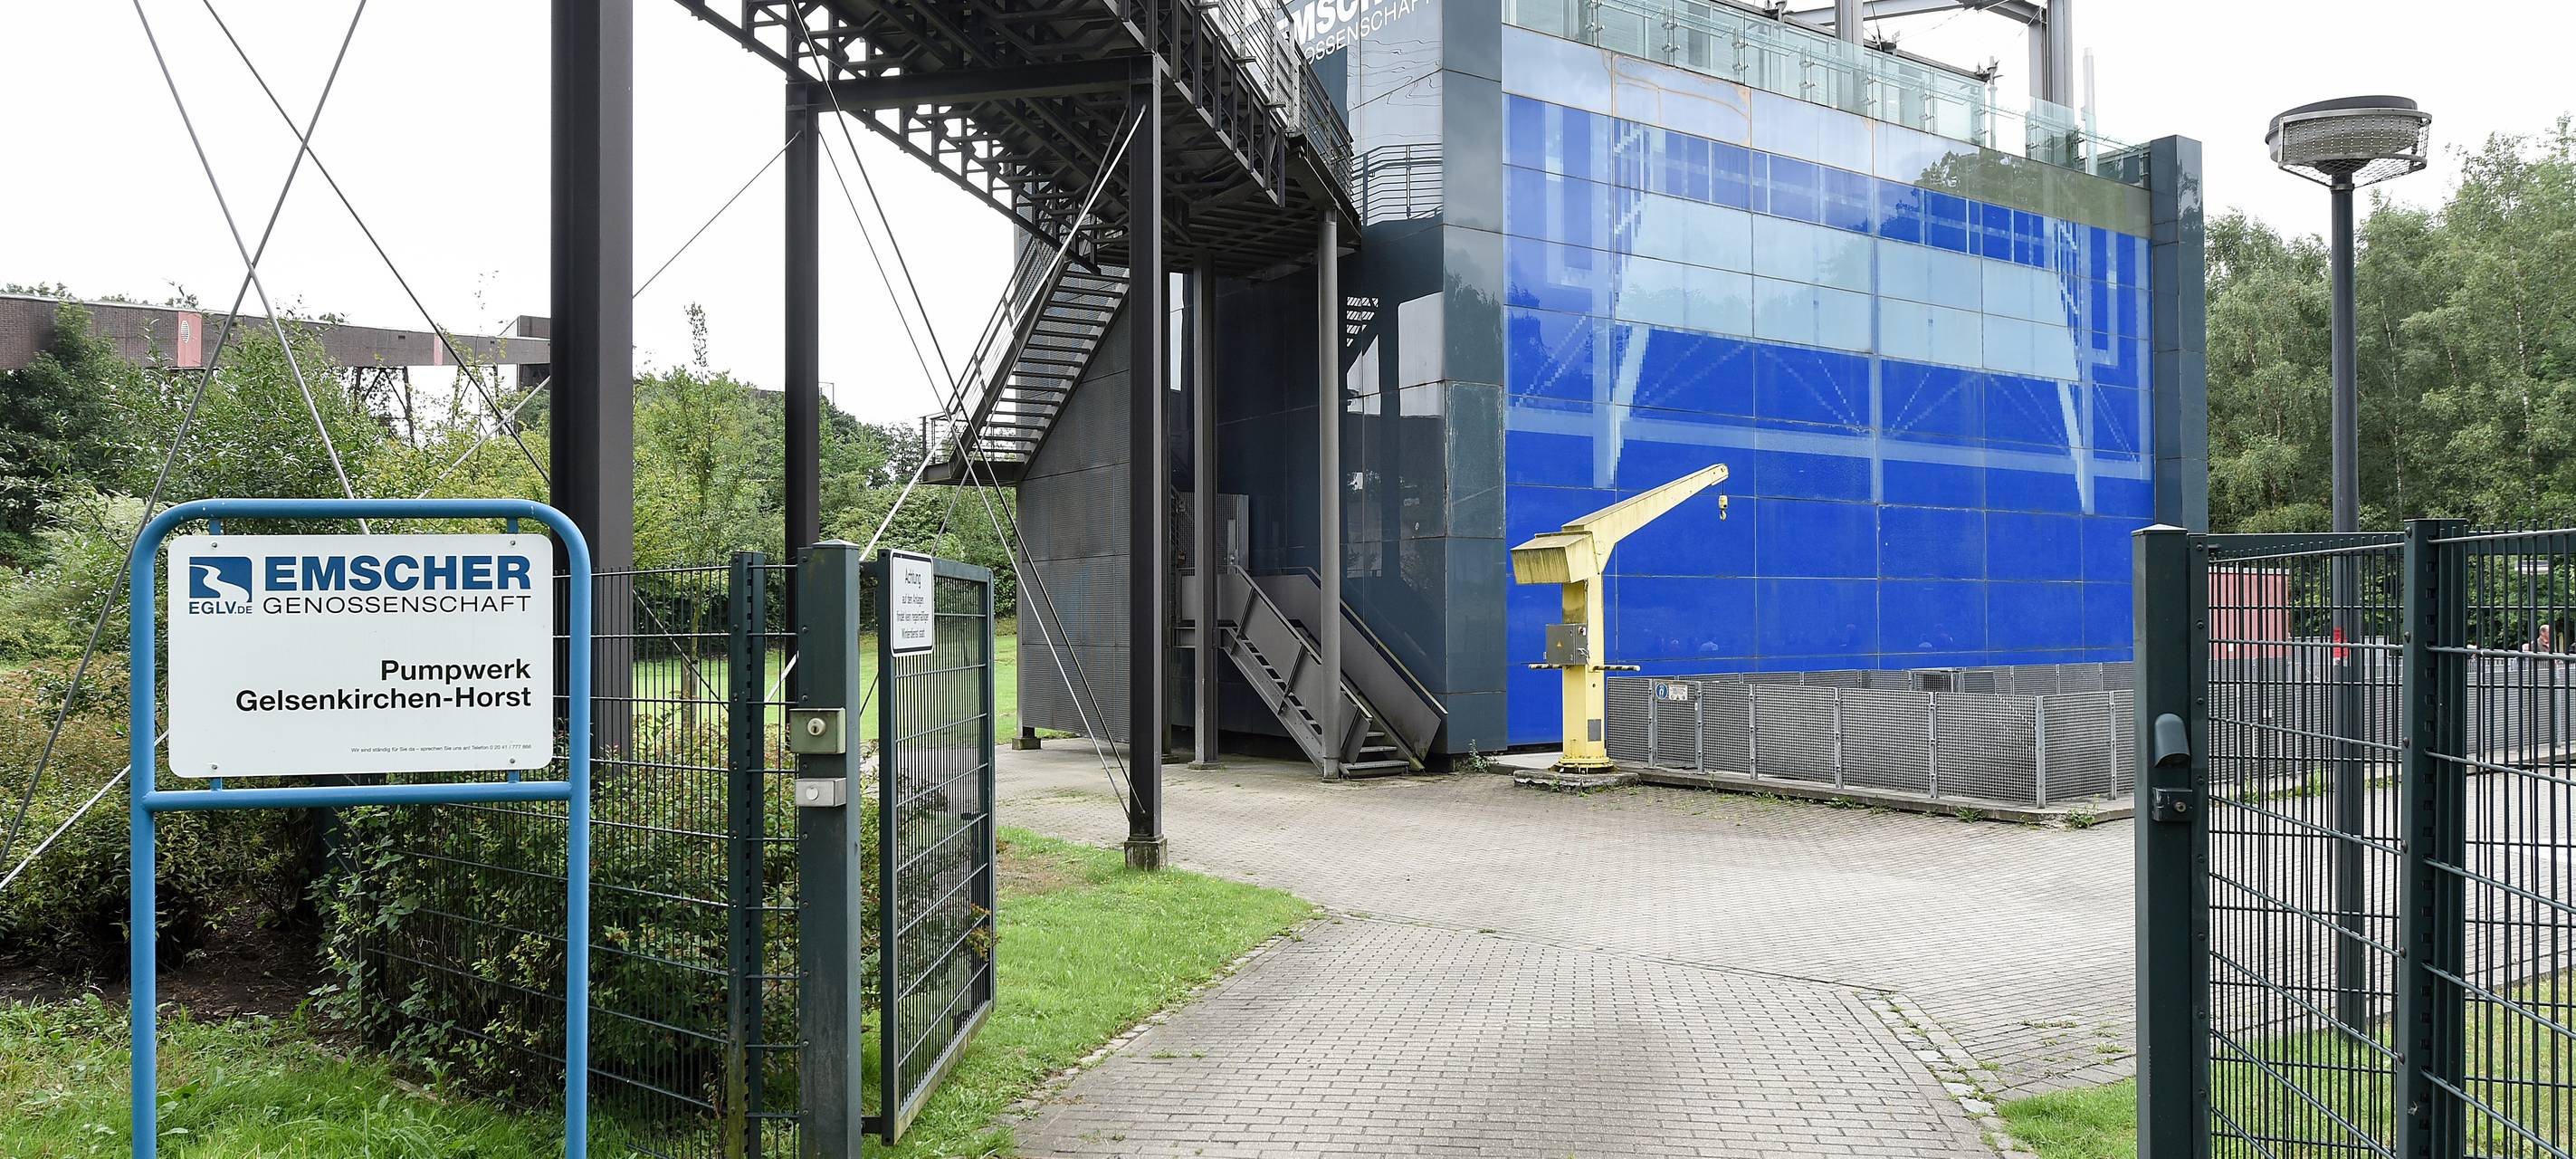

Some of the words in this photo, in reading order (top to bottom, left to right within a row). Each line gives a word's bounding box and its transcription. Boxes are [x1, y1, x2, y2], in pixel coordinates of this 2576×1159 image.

[264, 555, 531, 591] EMSCHER
[904, 568, 921, 589] Achtung
[188, 600, 253, 615] EGLV.DE
[262, 595, 532, 614] GENOSSENSCHAFT
[381, 658, 532, 685] Pumpwerk
[235, 686, 532, 712] Gelsenkirchen-Horst
[420, 745, 443, 753] sprechen
